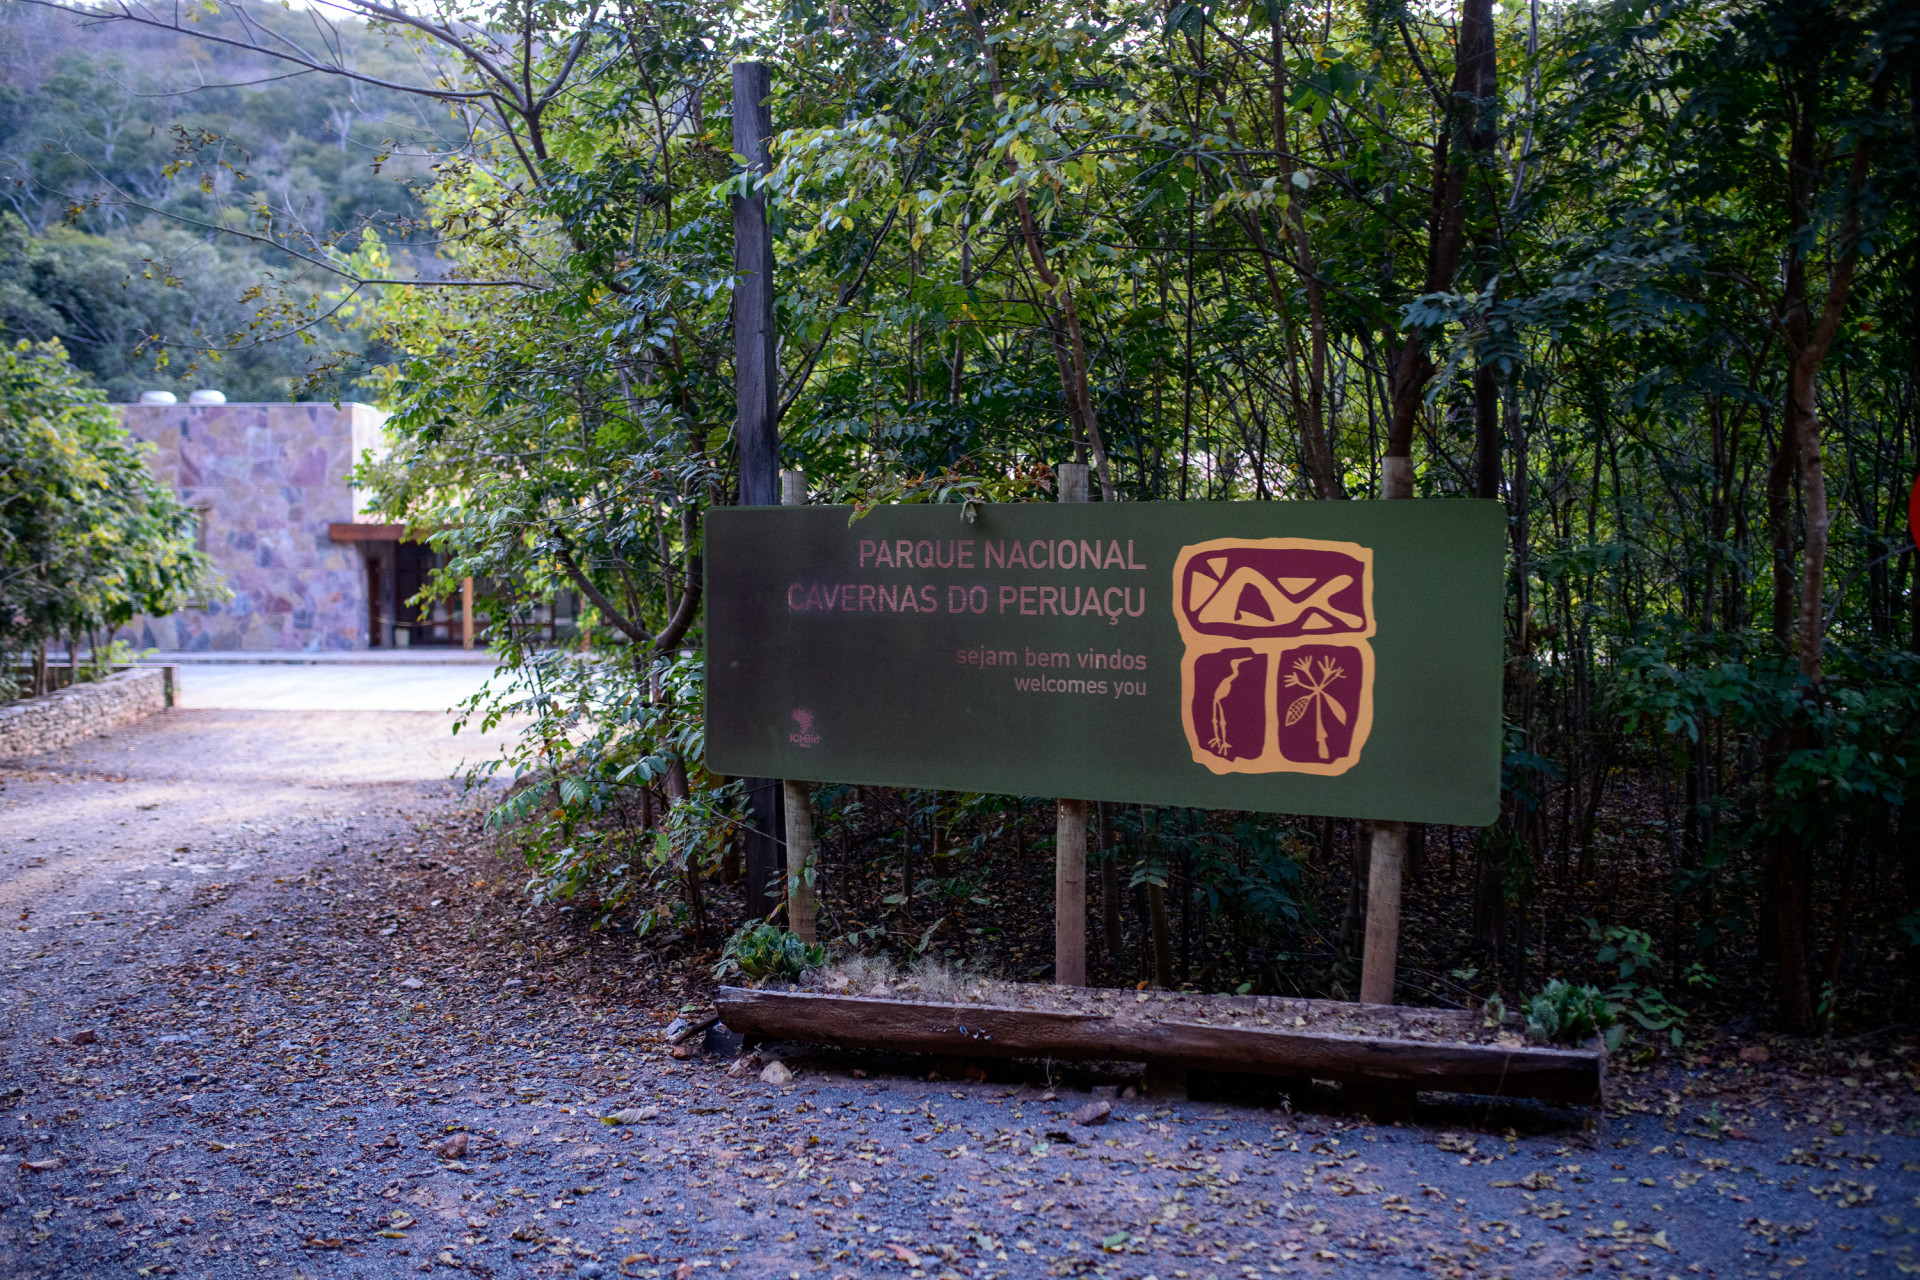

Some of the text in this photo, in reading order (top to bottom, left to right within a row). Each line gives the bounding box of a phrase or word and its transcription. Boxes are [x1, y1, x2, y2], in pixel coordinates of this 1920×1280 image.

[859, 539, 1148, 570] PARQUE NACIONAL
[788, 582, 1146, 626] CAVERNAS DO PERUAÇU
[956, 644, 1147, 670] sejam bem vindos
[1014, 674, 1147, 700] welcomes you
